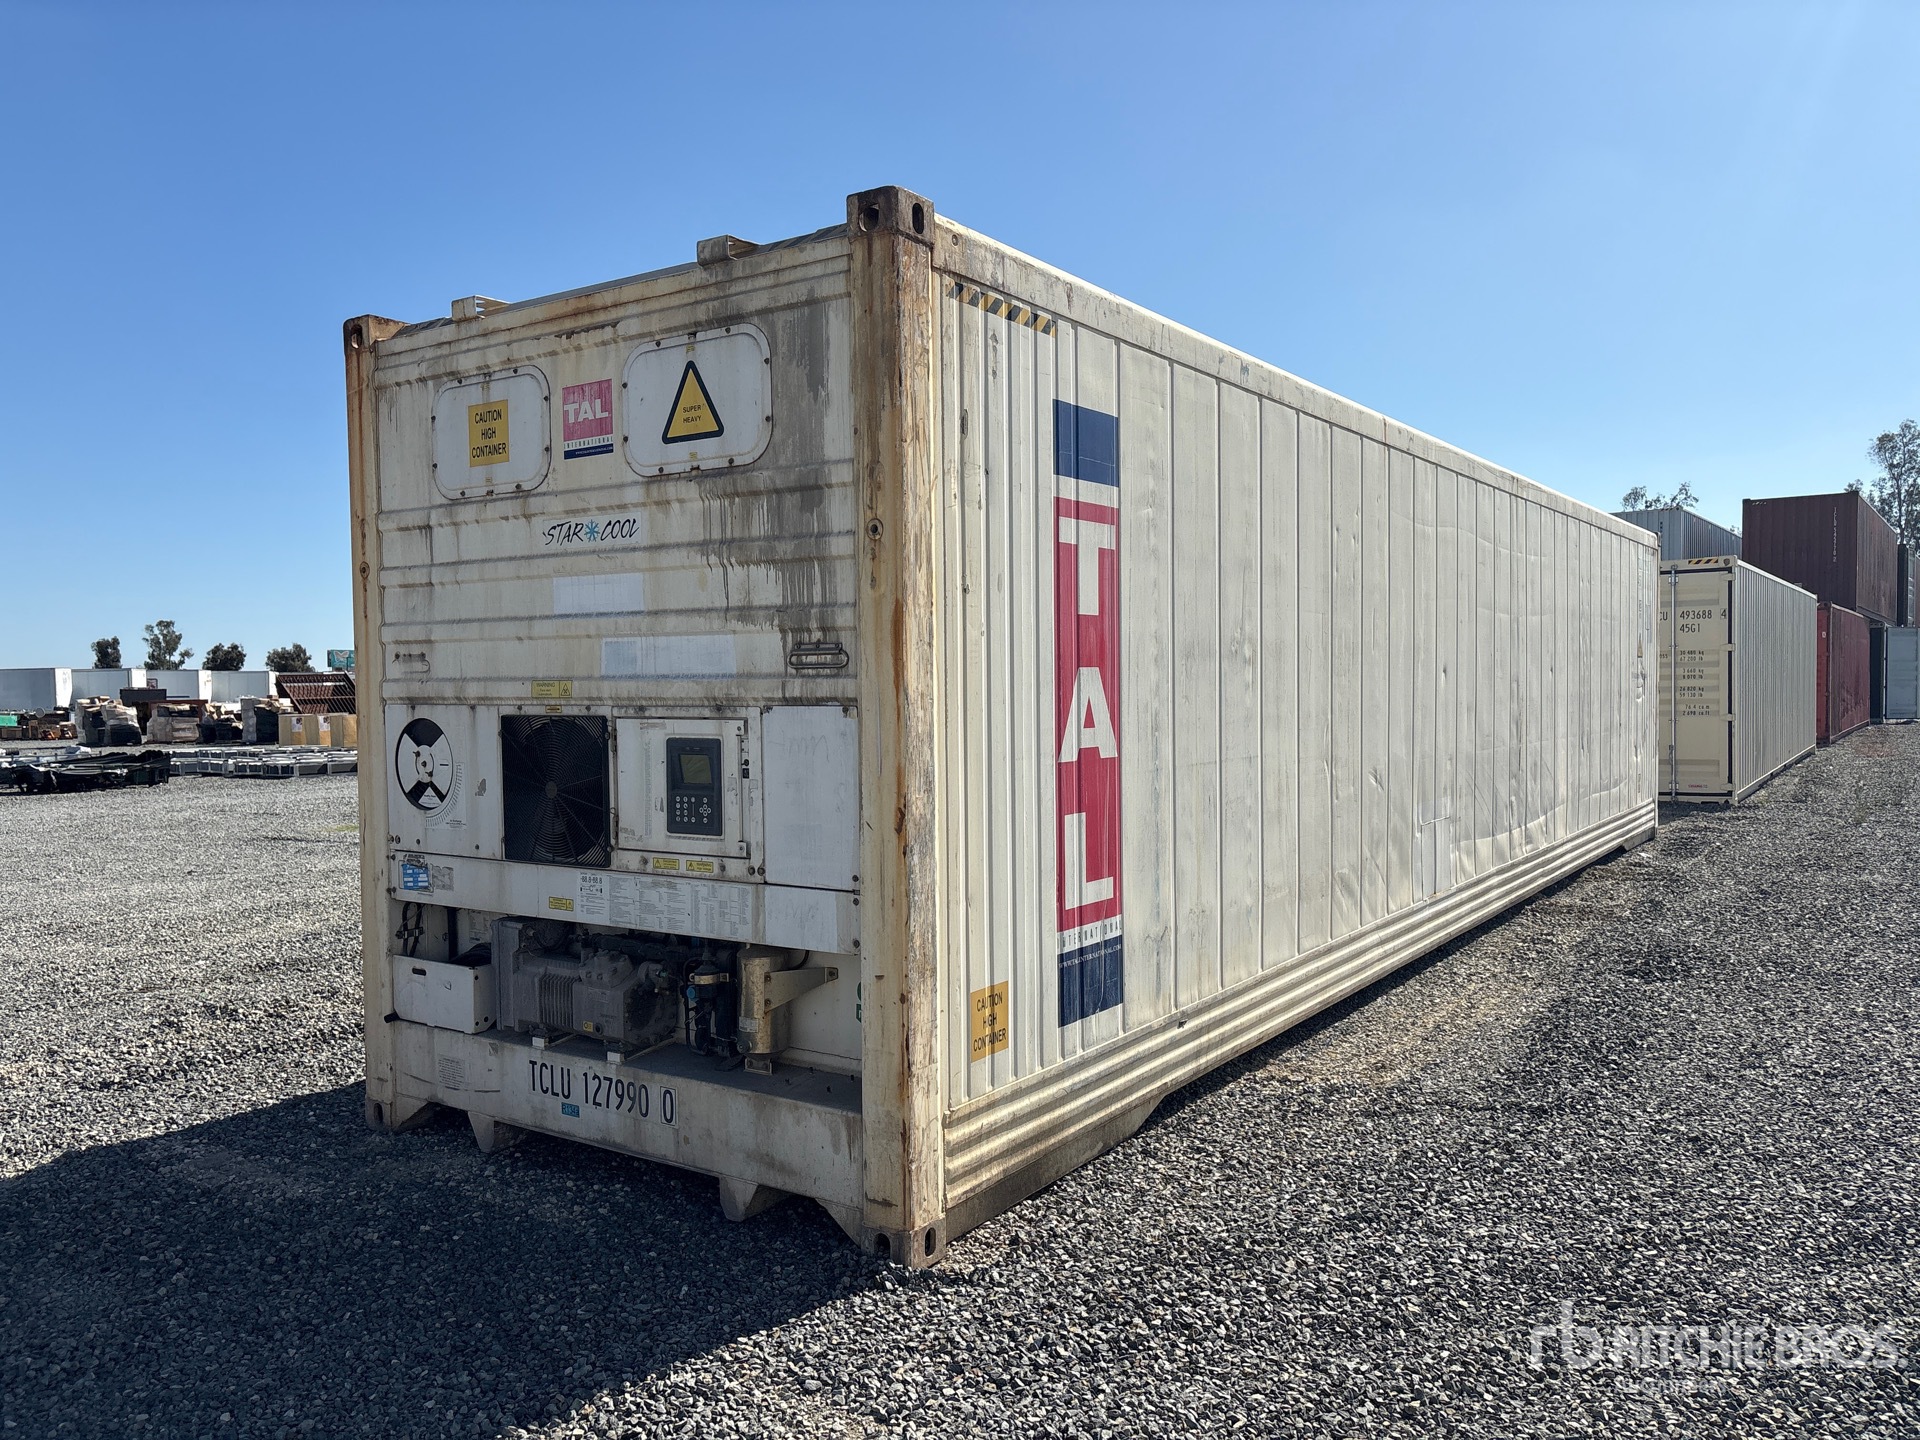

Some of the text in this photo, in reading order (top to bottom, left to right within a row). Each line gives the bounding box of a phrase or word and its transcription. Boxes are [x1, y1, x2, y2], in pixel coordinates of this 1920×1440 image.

[474, 408, 503, 424] CAUTION
[564, 398, 609, 424] TAL
[683, 404, 701, 414] SUPER
[683, 415, 702, 424] HEAVY
[481, 427, 497, 440] HIGH
[471, 442, 507, 459] CONTAINER
[564, 435, 613, 450] INTERNATIONAL
[543, 518, 640, 546] STAR COOL
[1679, 609, 1713, 620] 493688
[1720, 609, 1727, 619] 4
[1679, 623, 1701, 633] 45G1
[1057, 515, 1119, 911] TAL
[976, 991, 1003, 1012] CAUTION
[973, 1027, 1007, 1052] CONTAINER
[528, 1059, 674, 1124] TCLU 127990 0
